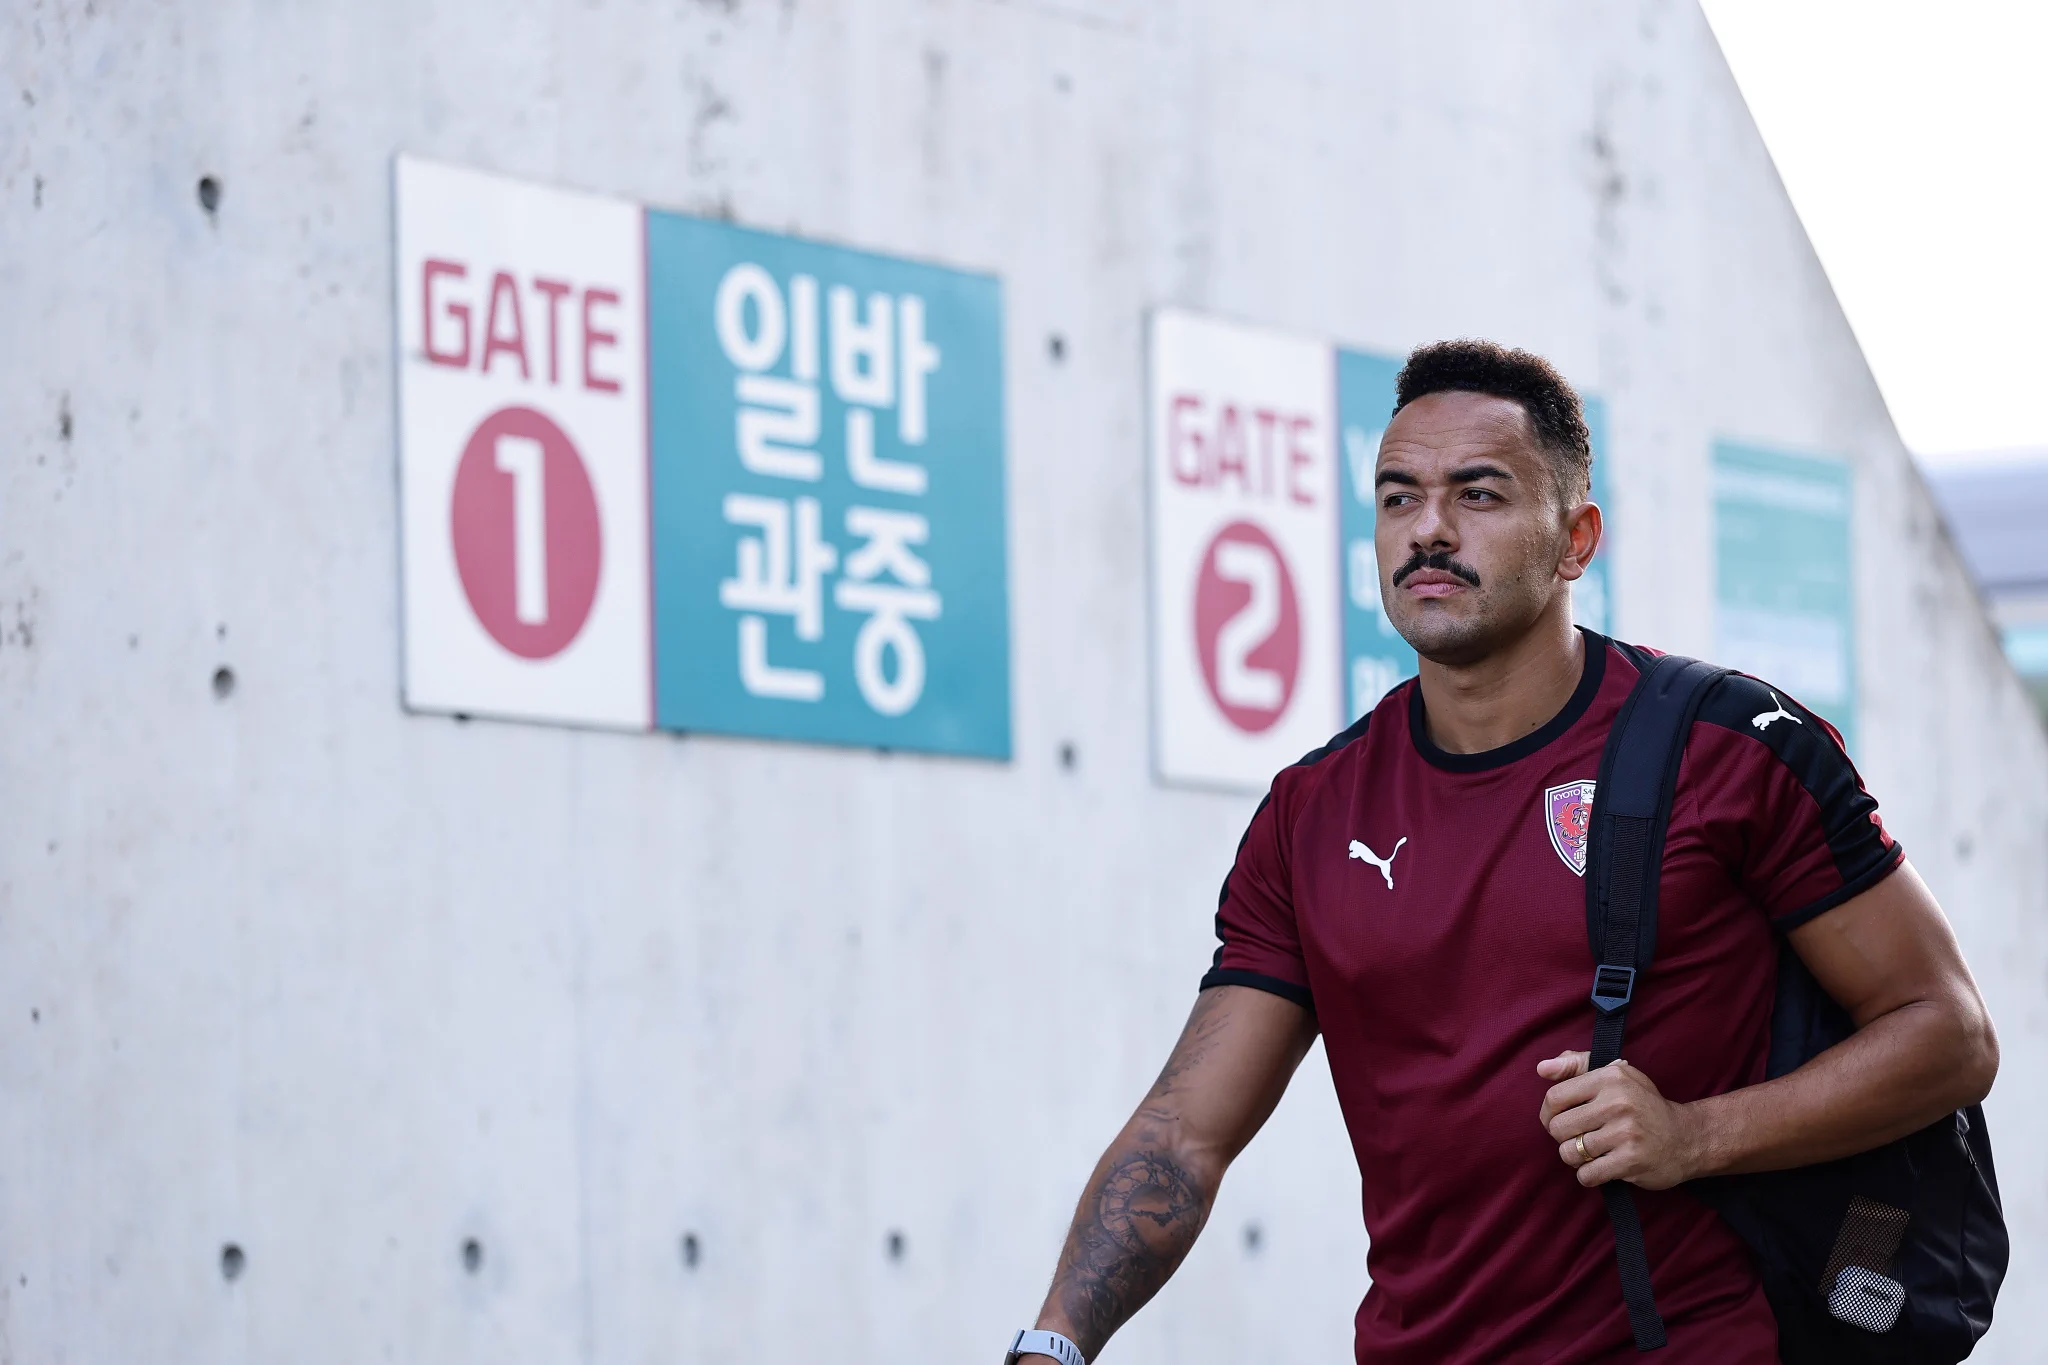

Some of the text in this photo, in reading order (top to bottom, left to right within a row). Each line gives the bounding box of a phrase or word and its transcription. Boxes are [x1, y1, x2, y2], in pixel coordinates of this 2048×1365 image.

[423, 258, 622, 393] GATE
[714, 262, 941, 495] 일반
[494, 432, 548, 627] 1
[1170, 395, 1317, 507] GATE
[719, 492, 943, 717] 관중
[1214, 540, 1284, 710] 2
[1553, 788, 1581, 802] KYOTO
